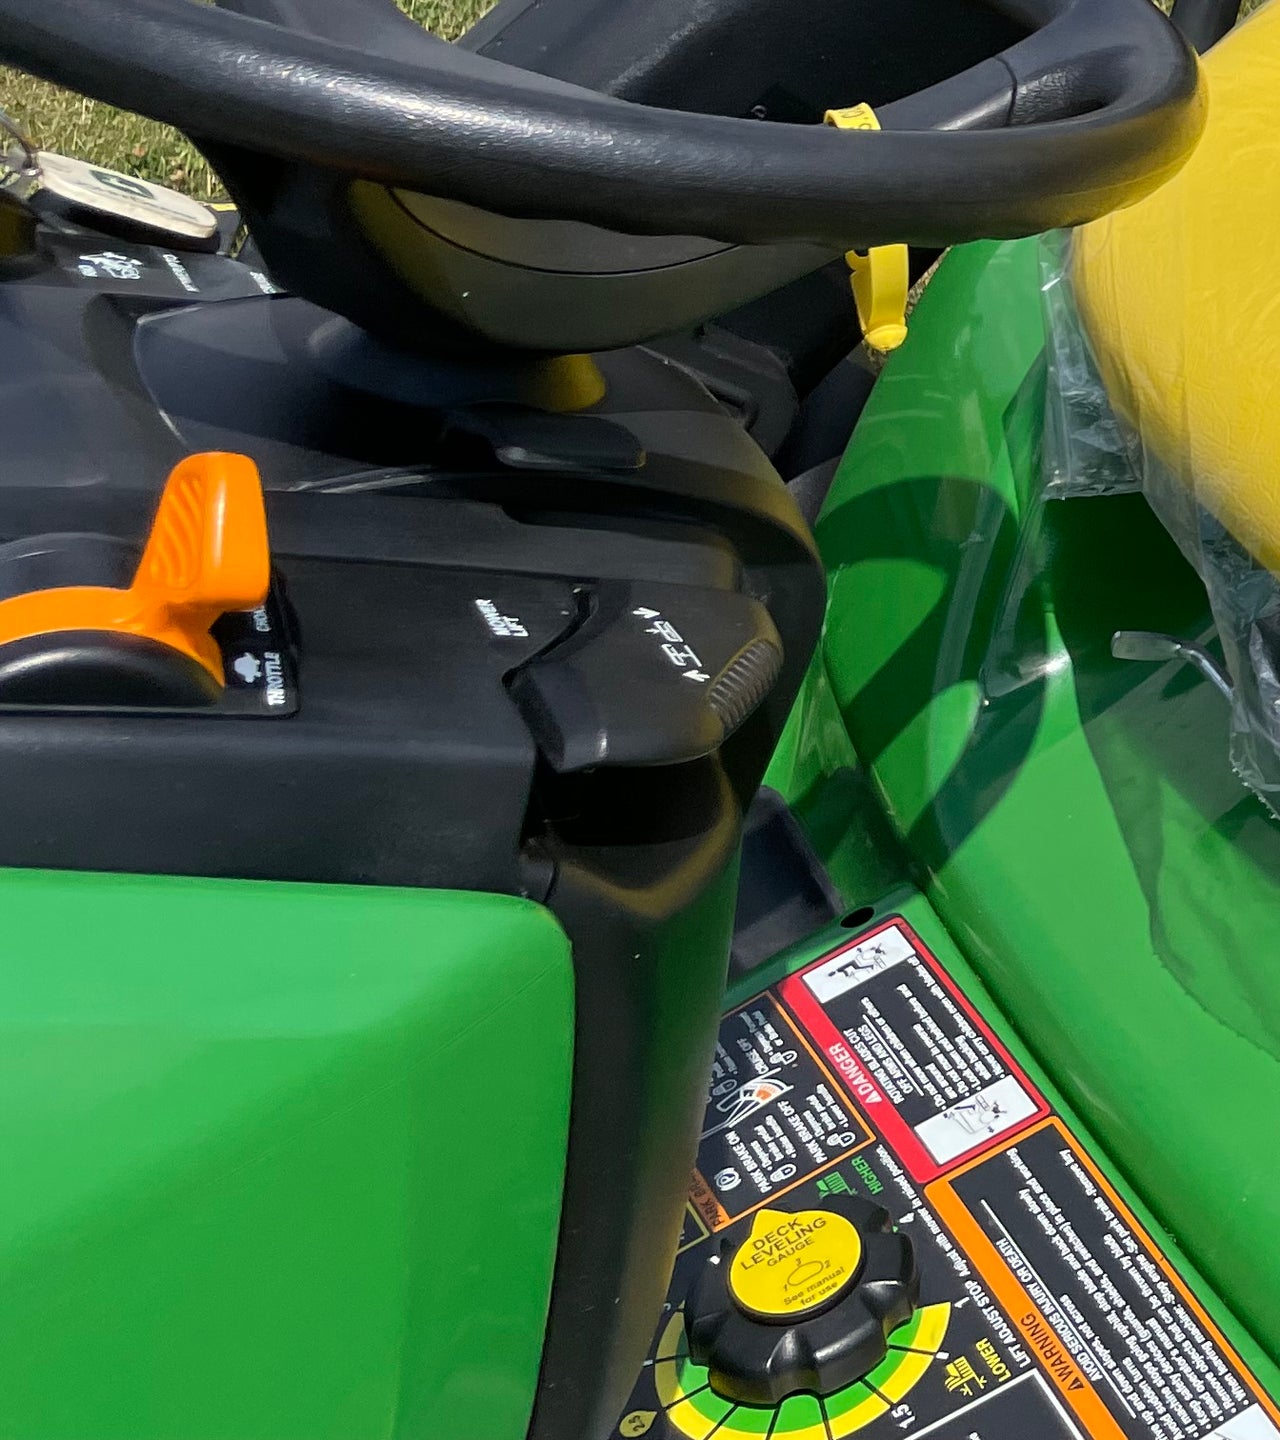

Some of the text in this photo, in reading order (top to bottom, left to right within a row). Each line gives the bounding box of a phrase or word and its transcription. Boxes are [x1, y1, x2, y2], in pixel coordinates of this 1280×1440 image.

[503, 615, 529, 637] LIFT
[264, 651, 286, 706] THROTTLE
[736, 1035, 769, 1075] CRUISE OFF
[827, 1040, 874, 1096] DANGER
[843, 1026, 904, 1104] ROTATING BLADES CUT
[857, 1023, 914, 1094] OFF ARMS AND LEGS
[776, 1097, 827, 1163] PARK BRAKE OFF
[724, 1129, 772, 1193] PARK BRAKE ON
[1004, 1146, 1035, 1179] working
[1057, 1146, 1077, 1165] key
[849, 1154, 884, 1194] HIGHER
[1026, 1177, 1044, 1195] and
[897, 1210, 918, 1227] 4
[1037, 1191, 1061, 1216] place
[1052, 1213, 1065, 1224] in
[1091, 1195, 1116, 1221] brake
[752, 1217, 803, 1251] DECK
[1033, 1211, 1057, 1236] down
[1108, 1216, 1130, 1239] park
[740, 1217, 827, 1271] LEVELING
[767, 1236, 816, 1267] GAUGE
[872, 1142, 1032, 1367] LIFT ADJUST STOP Adjust with mower in raised position.
[1049, 1233, 1070, 1256] back
[1057, 1220, 1094, 1261] switches)
[795, 1257, 802, 1267] 3
[825, 1260, 831, 1269] 2
[1062, 1252, 1082, 1271] and
[1085, 1258, 1104, 1276] and
[1134, 1251, 1163, 1283] engine
[784, 1266, 846, 1306] See manual
[800, 1281, 839, 1306] for use
[1074, 1268, 1098, 1294] blade
[953, 1295, 972, 1310] 1
[995, 1236, 1103, 1382] AVOID SERIOUS INJURY OR DEATH
[1091, 1289, 1114, 1312] stop
[1100, 1232, 1236, 1408] Remove objects that can be thrown by blade
[1171, 1303, 1206, 1343] machine:
[973, 1336, 1012, 1382] LOWER
[1017, 1311, 1076, 1382] WARNING
[1058, 1293, 1158, 1424] up and down slopes, not across
[1123, 1334, 1150, 1363] going
[1143, 1339, 1175, 1375] devices
[1198, 1339, 1231, 1374] leaving
[1142, 1359, 1168, 1387] stops
[1144, 1316, 1223, 1416] Read operator's manual
[1120, 1356, 1186, 1440] Avoid sudden turns
[1167, 1371, 1196, 1402] safety
[1222, 1372, 1248, 1399] When
[889, 1401, 918, 1430] 1.5
[1158, 1385, 1193, 1425] machine
[1186, 1398, 1212, 1425] Keep
[1185, 1423, 1198, 1433] If
